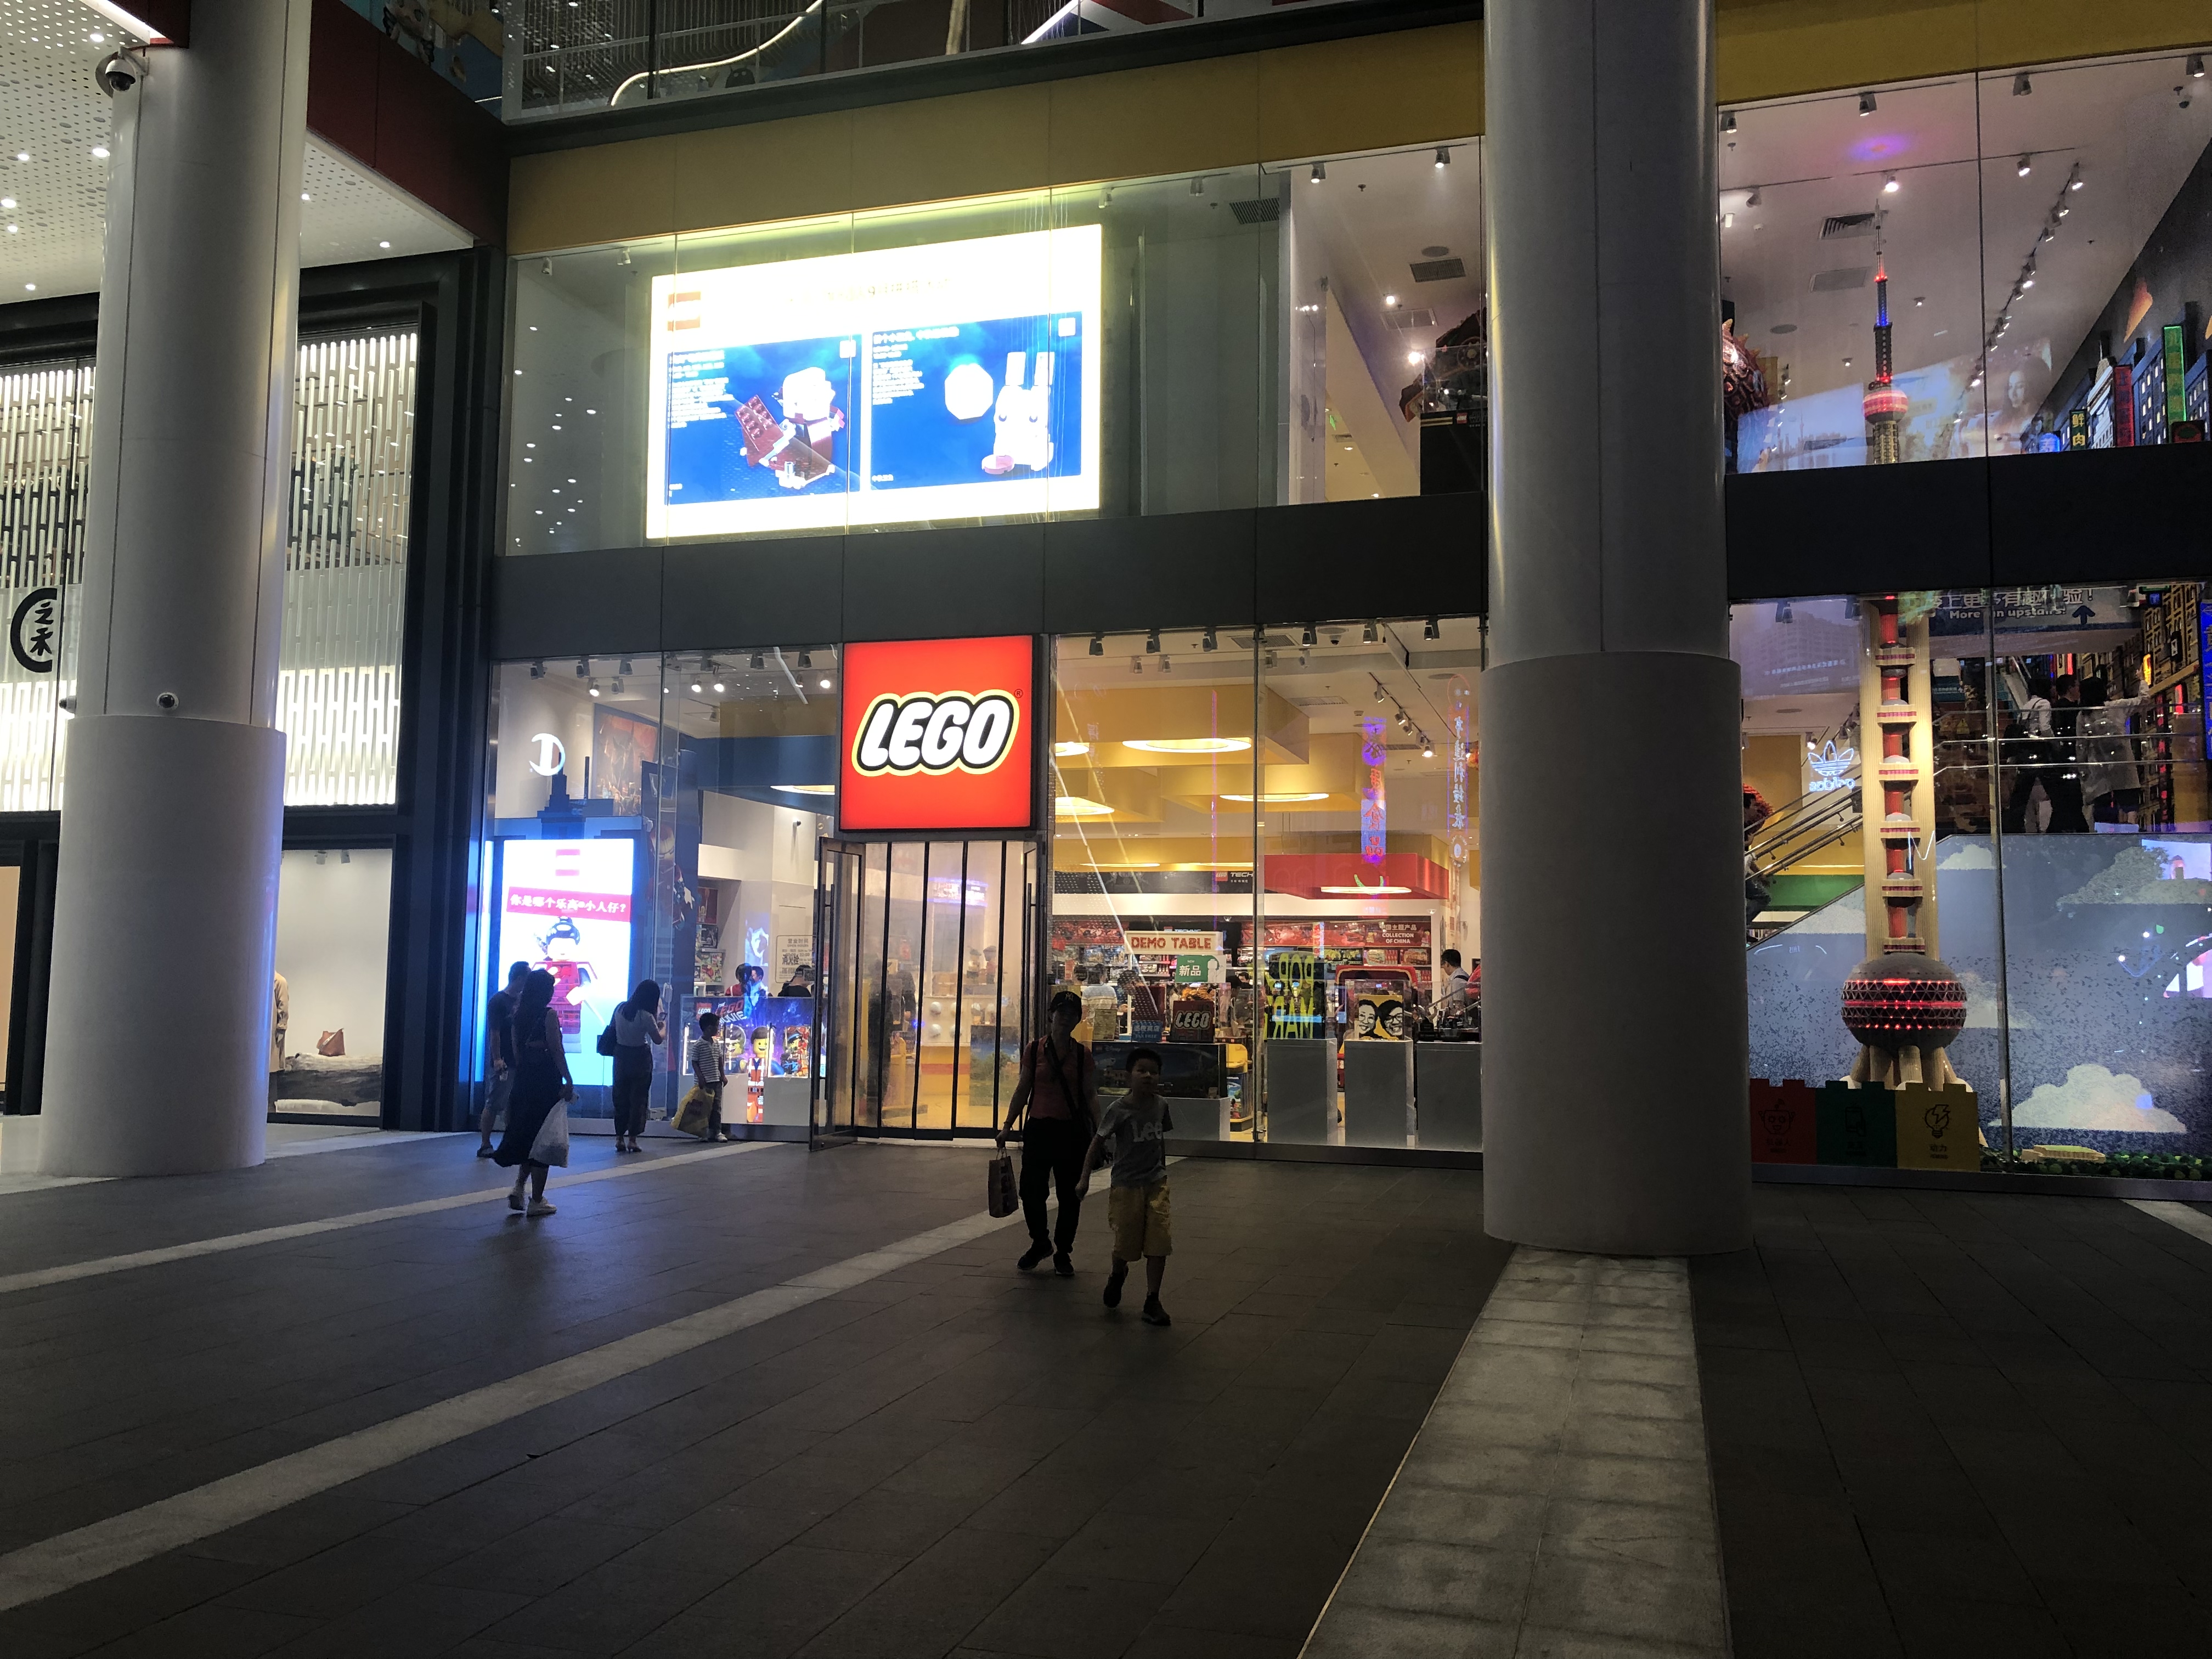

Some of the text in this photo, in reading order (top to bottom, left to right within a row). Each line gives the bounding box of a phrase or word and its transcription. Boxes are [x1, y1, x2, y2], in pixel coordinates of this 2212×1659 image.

[1949, 610, 1981, 619] More
[30, 601, 54, 656] 之禾
[856, 693, 1015, 772] LEGO
[1131, 936, 1212, 950] DEMO TABLE
[1178, 964, 1201, 977] 新品
[714, 998, 744, 1016] LEGO
[1173, 1011, 1211, 1029] LEGO
